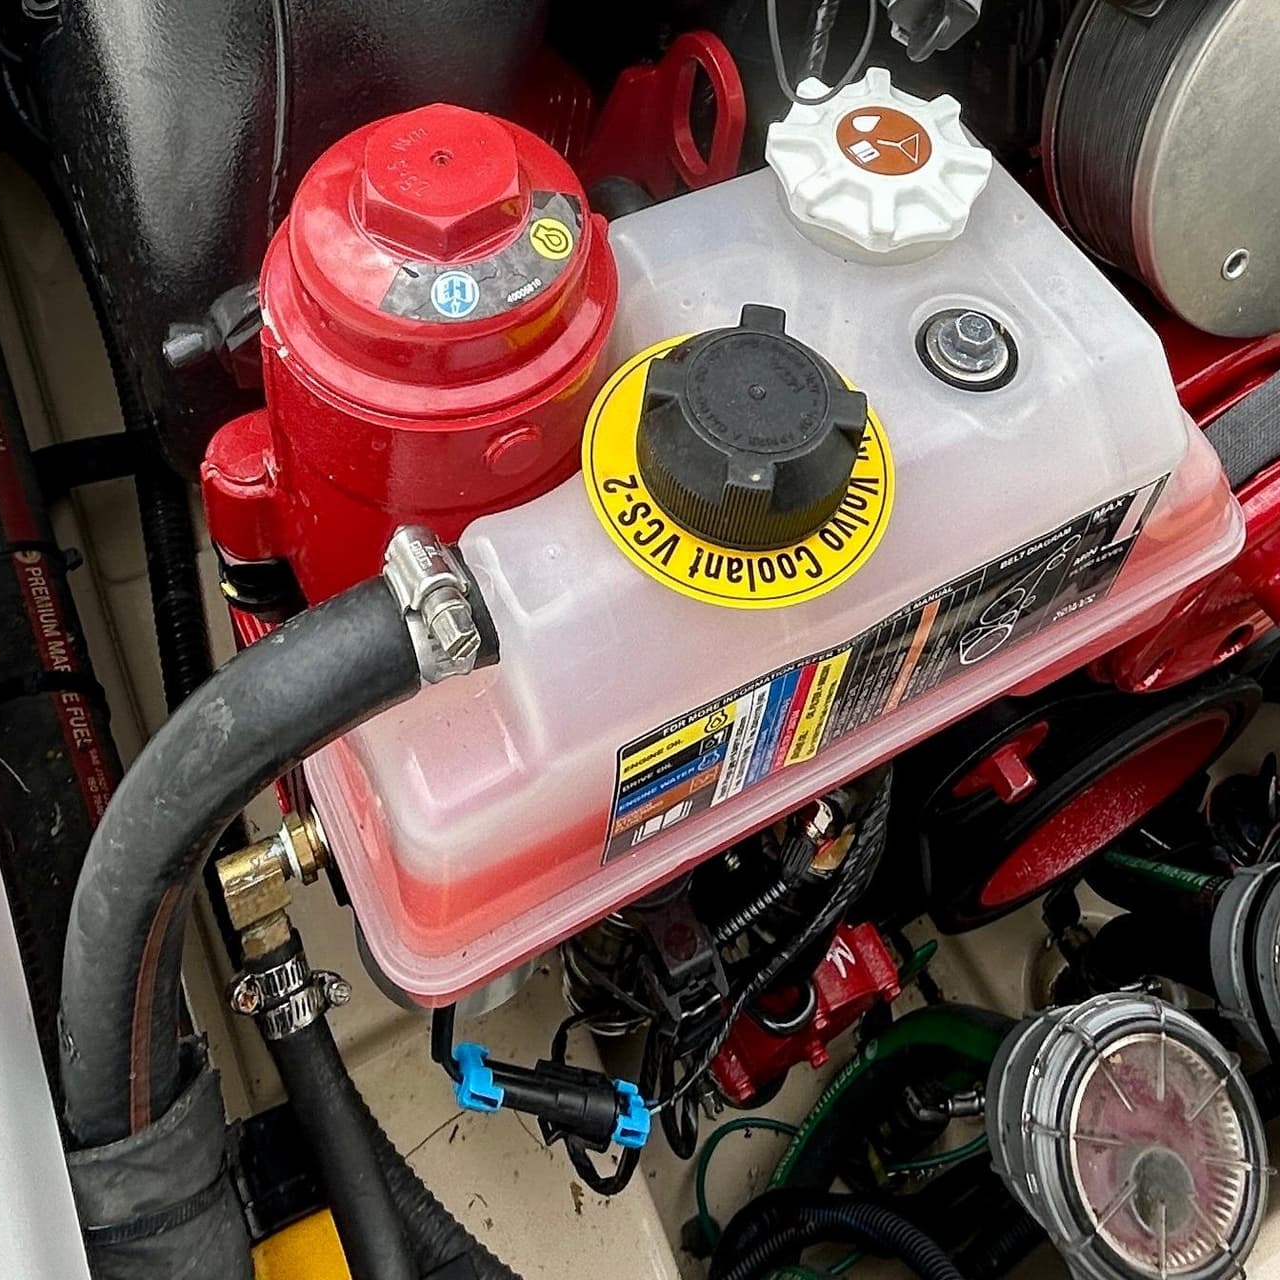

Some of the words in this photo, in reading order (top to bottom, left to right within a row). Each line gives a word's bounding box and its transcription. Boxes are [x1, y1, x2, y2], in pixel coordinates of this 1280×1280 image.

[602, 473, 682, 567] VCS-2
[819, 476, 880, 552] Volvo
[1092, 497, 1126, 522] MAX
[688, 544, 824, 593] Coolant
[999, 552, 1026, 570] BELT
[1026, 526, 1073, 558] DIAGRAM
[24, 566, 62, 639] PREMIUM
[662, 718, 686, 737] FOR
[687, 702, 720, 723] MORE
[722, 665, 796, 706] INFORMATION
[623, 748, 664, 774] ENGINE
[666, 737, 684, 752] OIL
[618, 786, 658, 812] ENGINE
[659, 767, 696, 790] WATER
[622, 773, 655, 794] DRIVE
